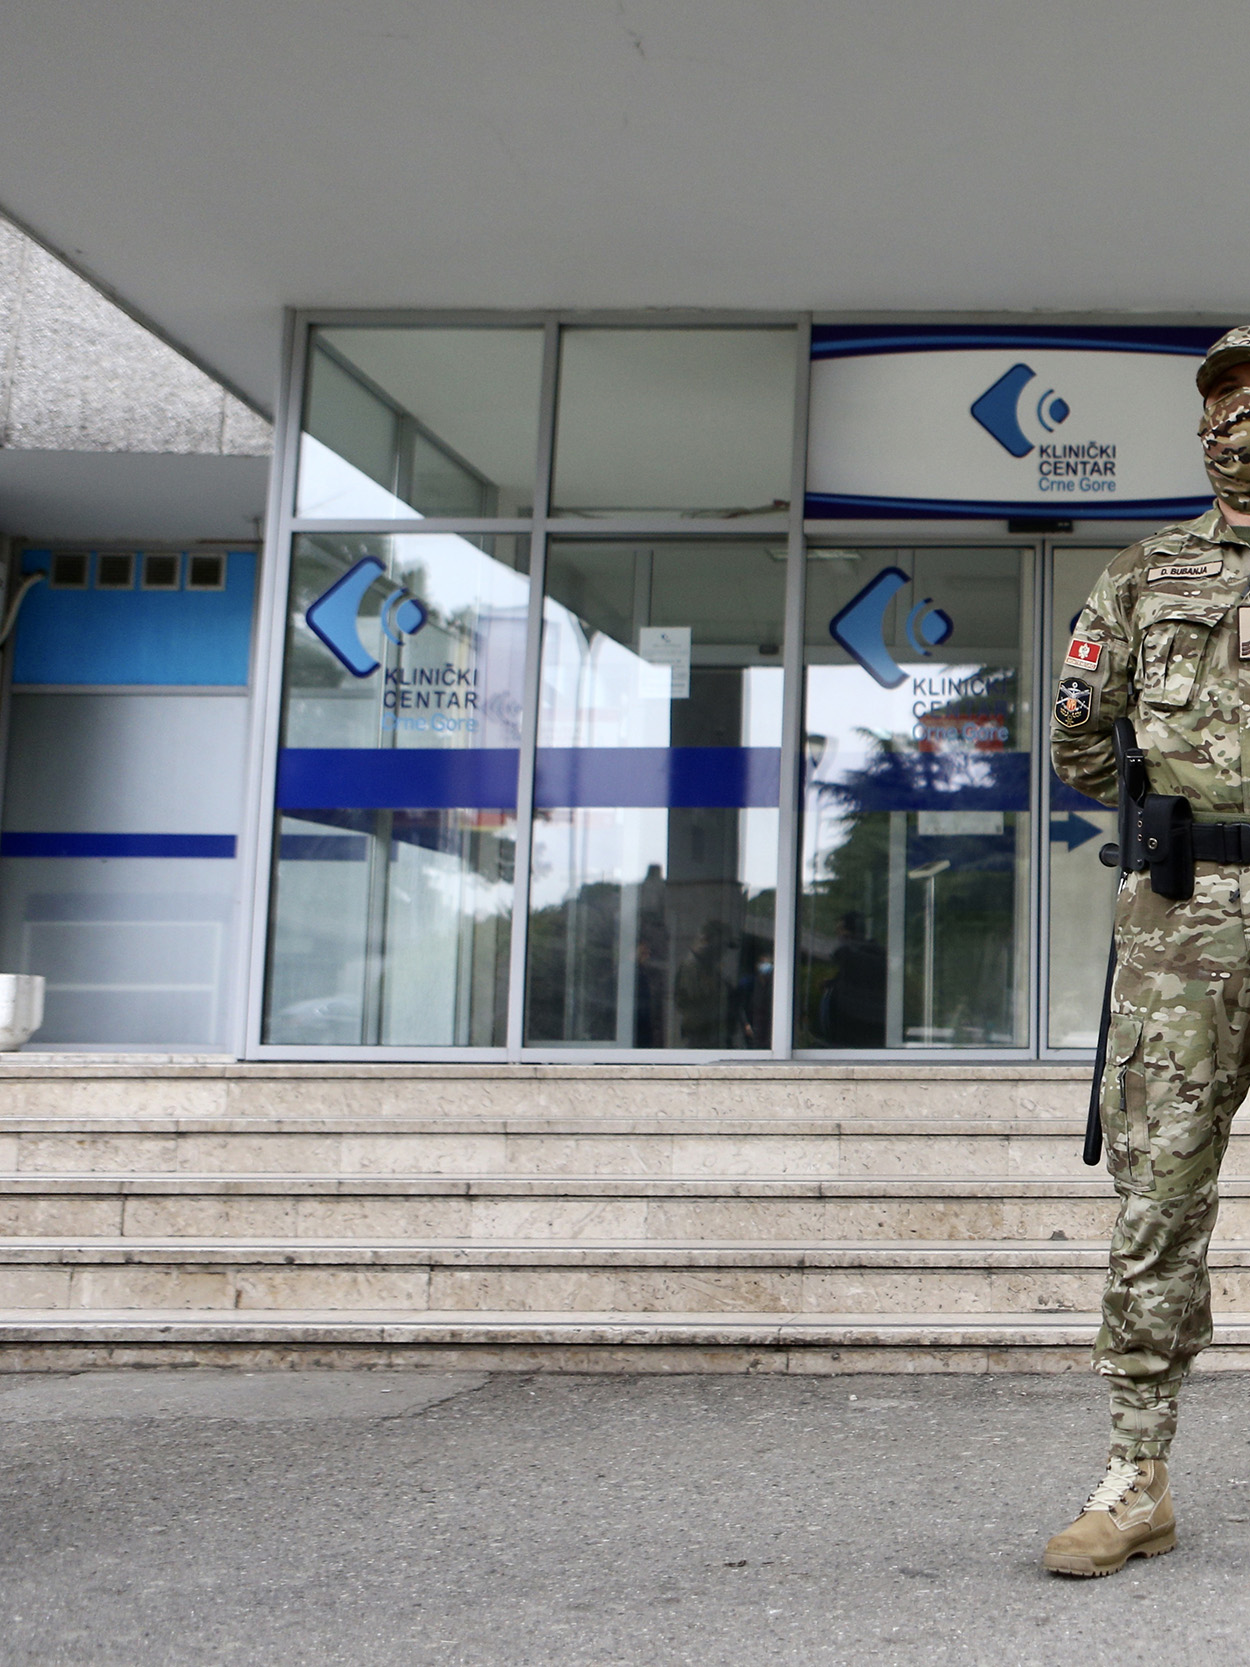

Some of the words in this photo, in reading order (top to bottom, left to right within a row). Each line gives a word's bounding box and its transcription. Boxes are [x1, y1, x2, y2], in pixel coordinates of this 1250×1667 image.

[1040, 441, 1116, 458] KLINIČKI
[1039, 461, 1116, 476] CENTAR
[1038, 477, 1075, 491] Crne
[1079, 477, 1116, 492] Gore
[1170, 566, 1207, 575] BUBANJA
[385, 663, 478, 686] KLINIČKI
[383, 690, 478, 709] CENTAR
[382, 712, 427, 731] Crne
[431, 712, 479, 732] Gore
[912, 722, 958, 741] Crne
[962, 722, 1009, 741] Gore
